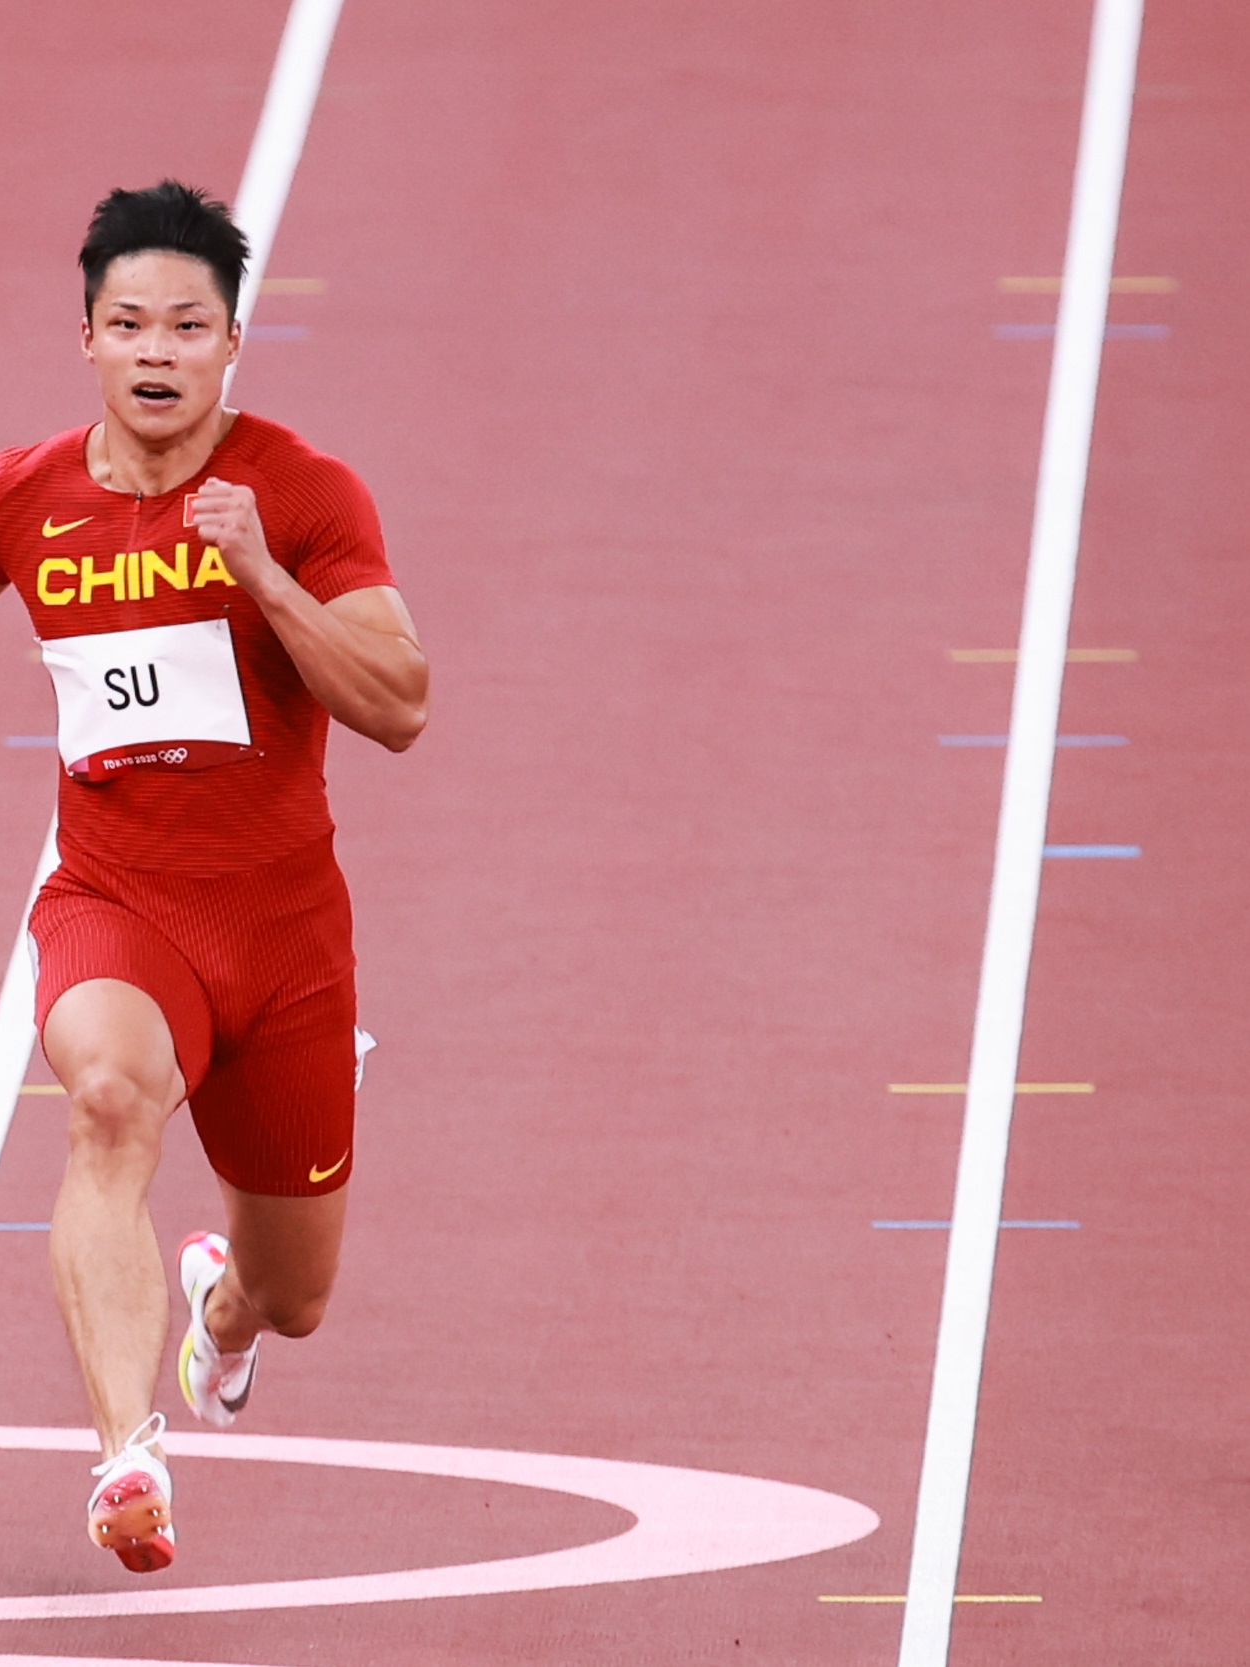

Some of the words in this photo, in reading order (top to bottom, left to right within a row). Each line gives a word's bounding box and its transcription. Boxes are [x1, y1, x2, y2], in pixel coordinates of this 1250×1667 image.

[37, 542, 238, 606] CHINA
[103, 663, 160, 711] SU
[134, 754, 158, 764] 2020
